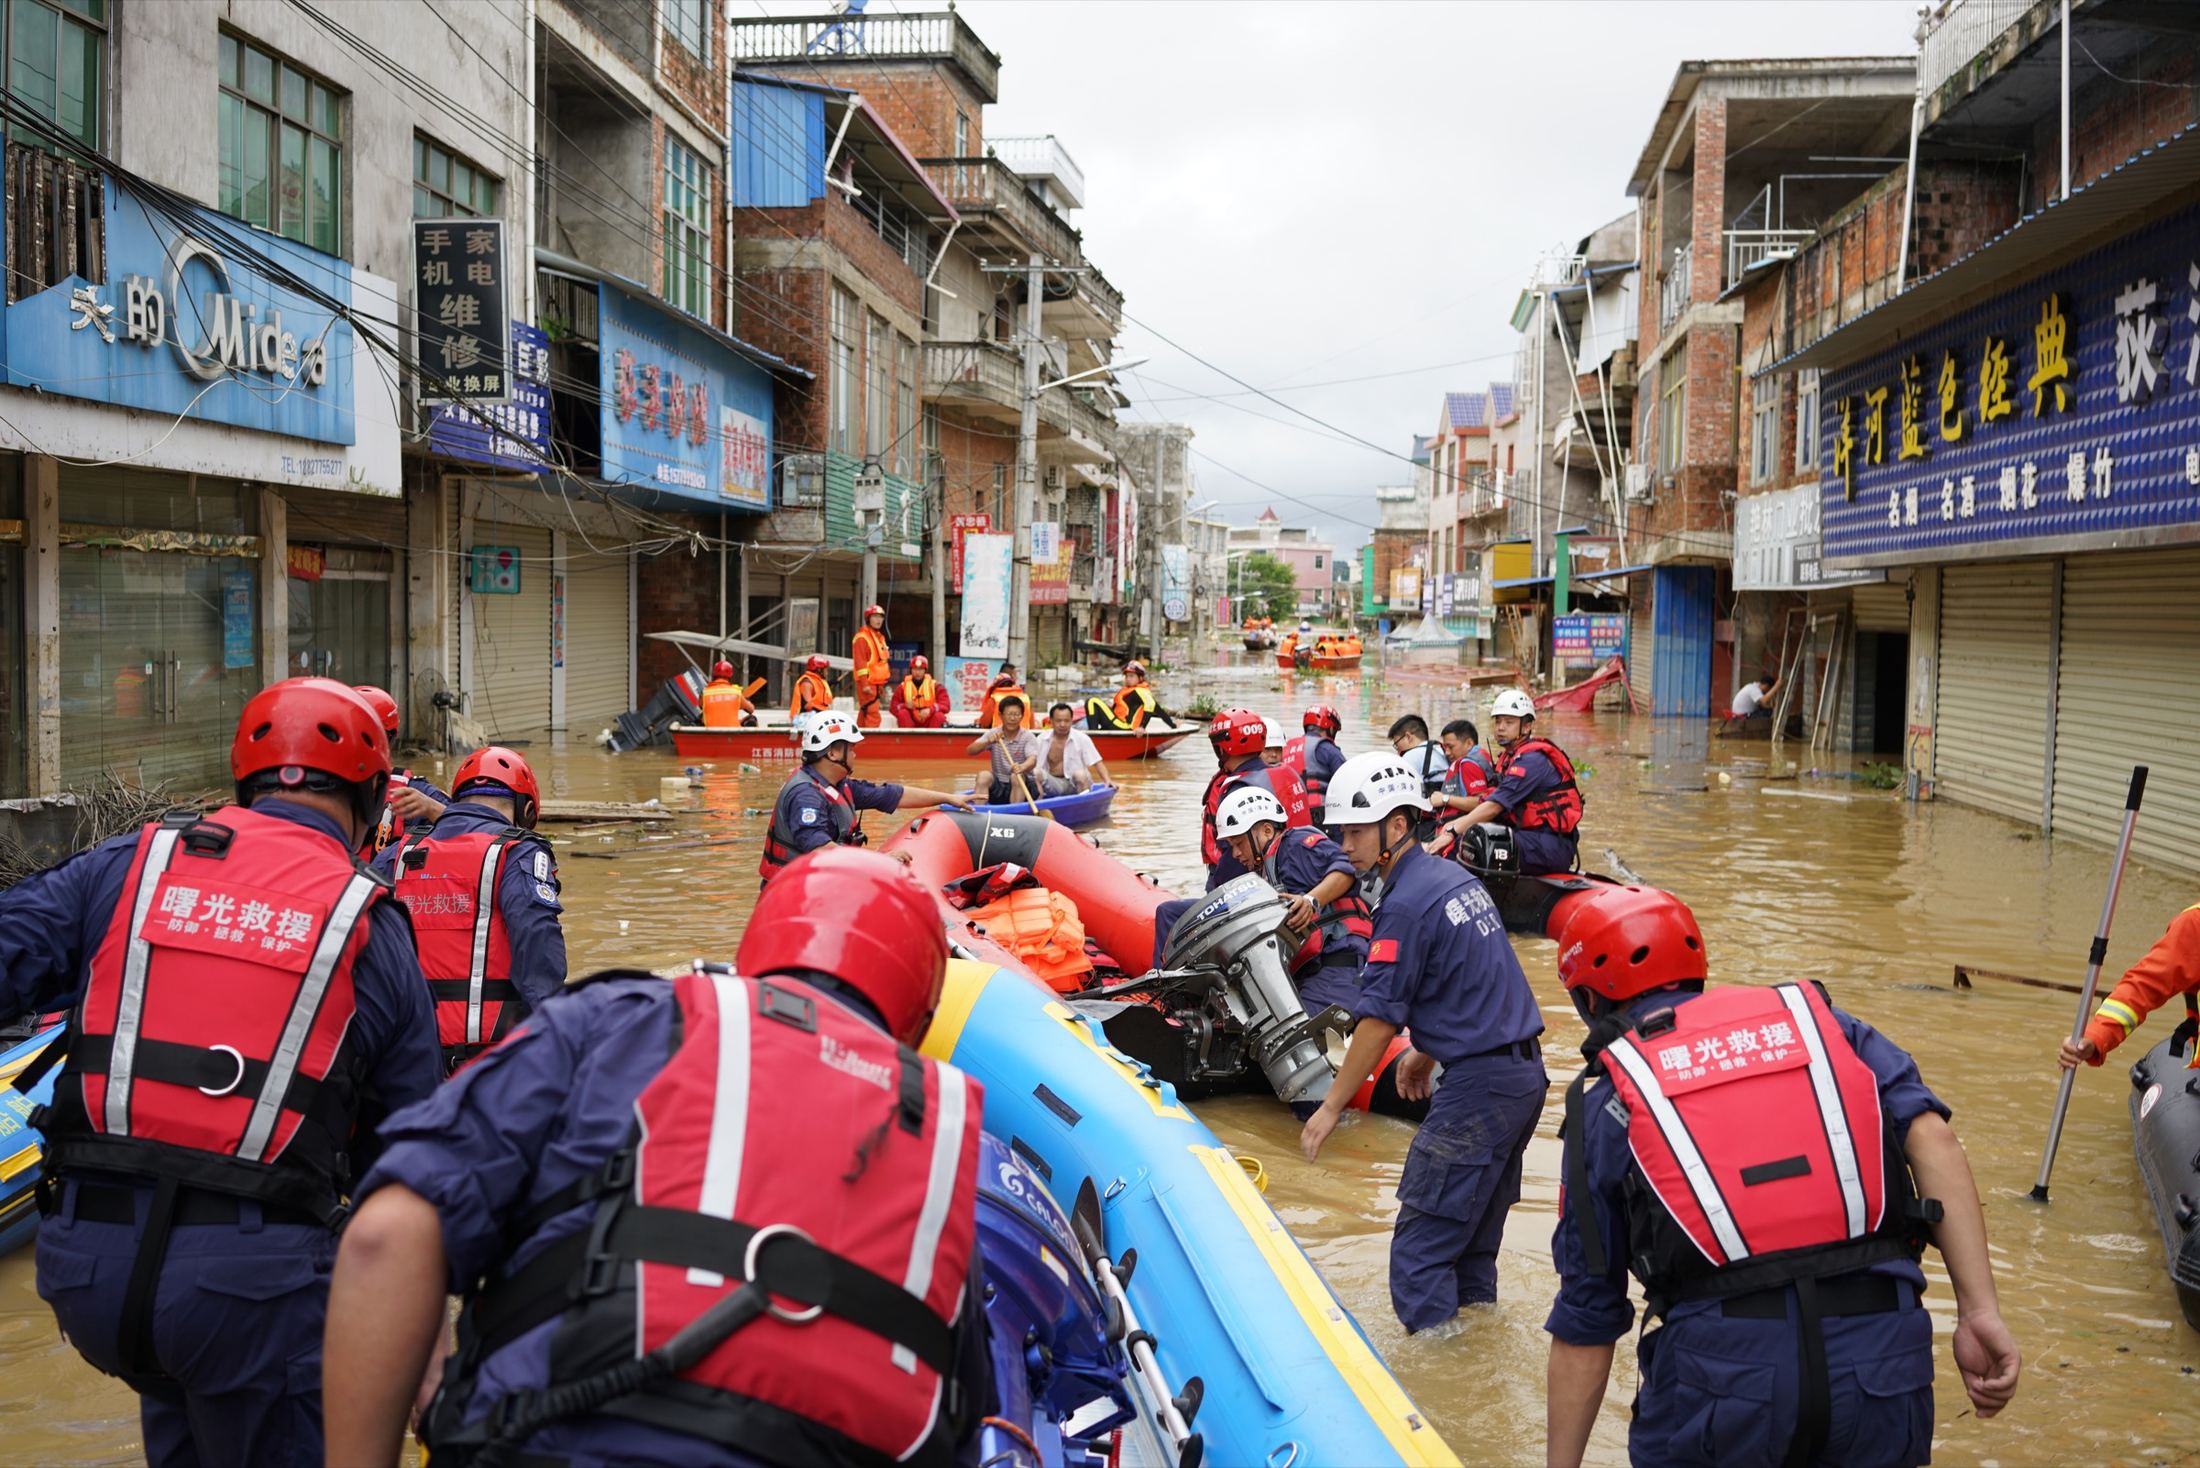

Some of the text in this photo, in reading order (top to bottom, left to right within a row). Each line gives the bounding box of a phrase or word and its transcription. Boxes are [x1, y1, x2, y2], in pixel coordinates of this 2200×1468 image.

[422, 229, 453, 286] 手机
[466, 229, 497, 287] 家电
[440, 294, 482, 370] 维修
[2115, 260, 2200, 404] 荻
[1941, 475, 1976, 521] 名酒
[2000, 461, 2038, 512] 烟花
[2067, 447, 2114, 502] 爆竹
[159, 886, 313, 943] 曙光救援
[1196, 879, 1259, 921] TOHATSU
[1658, 1021, 1796, 1071] 曙光救援
